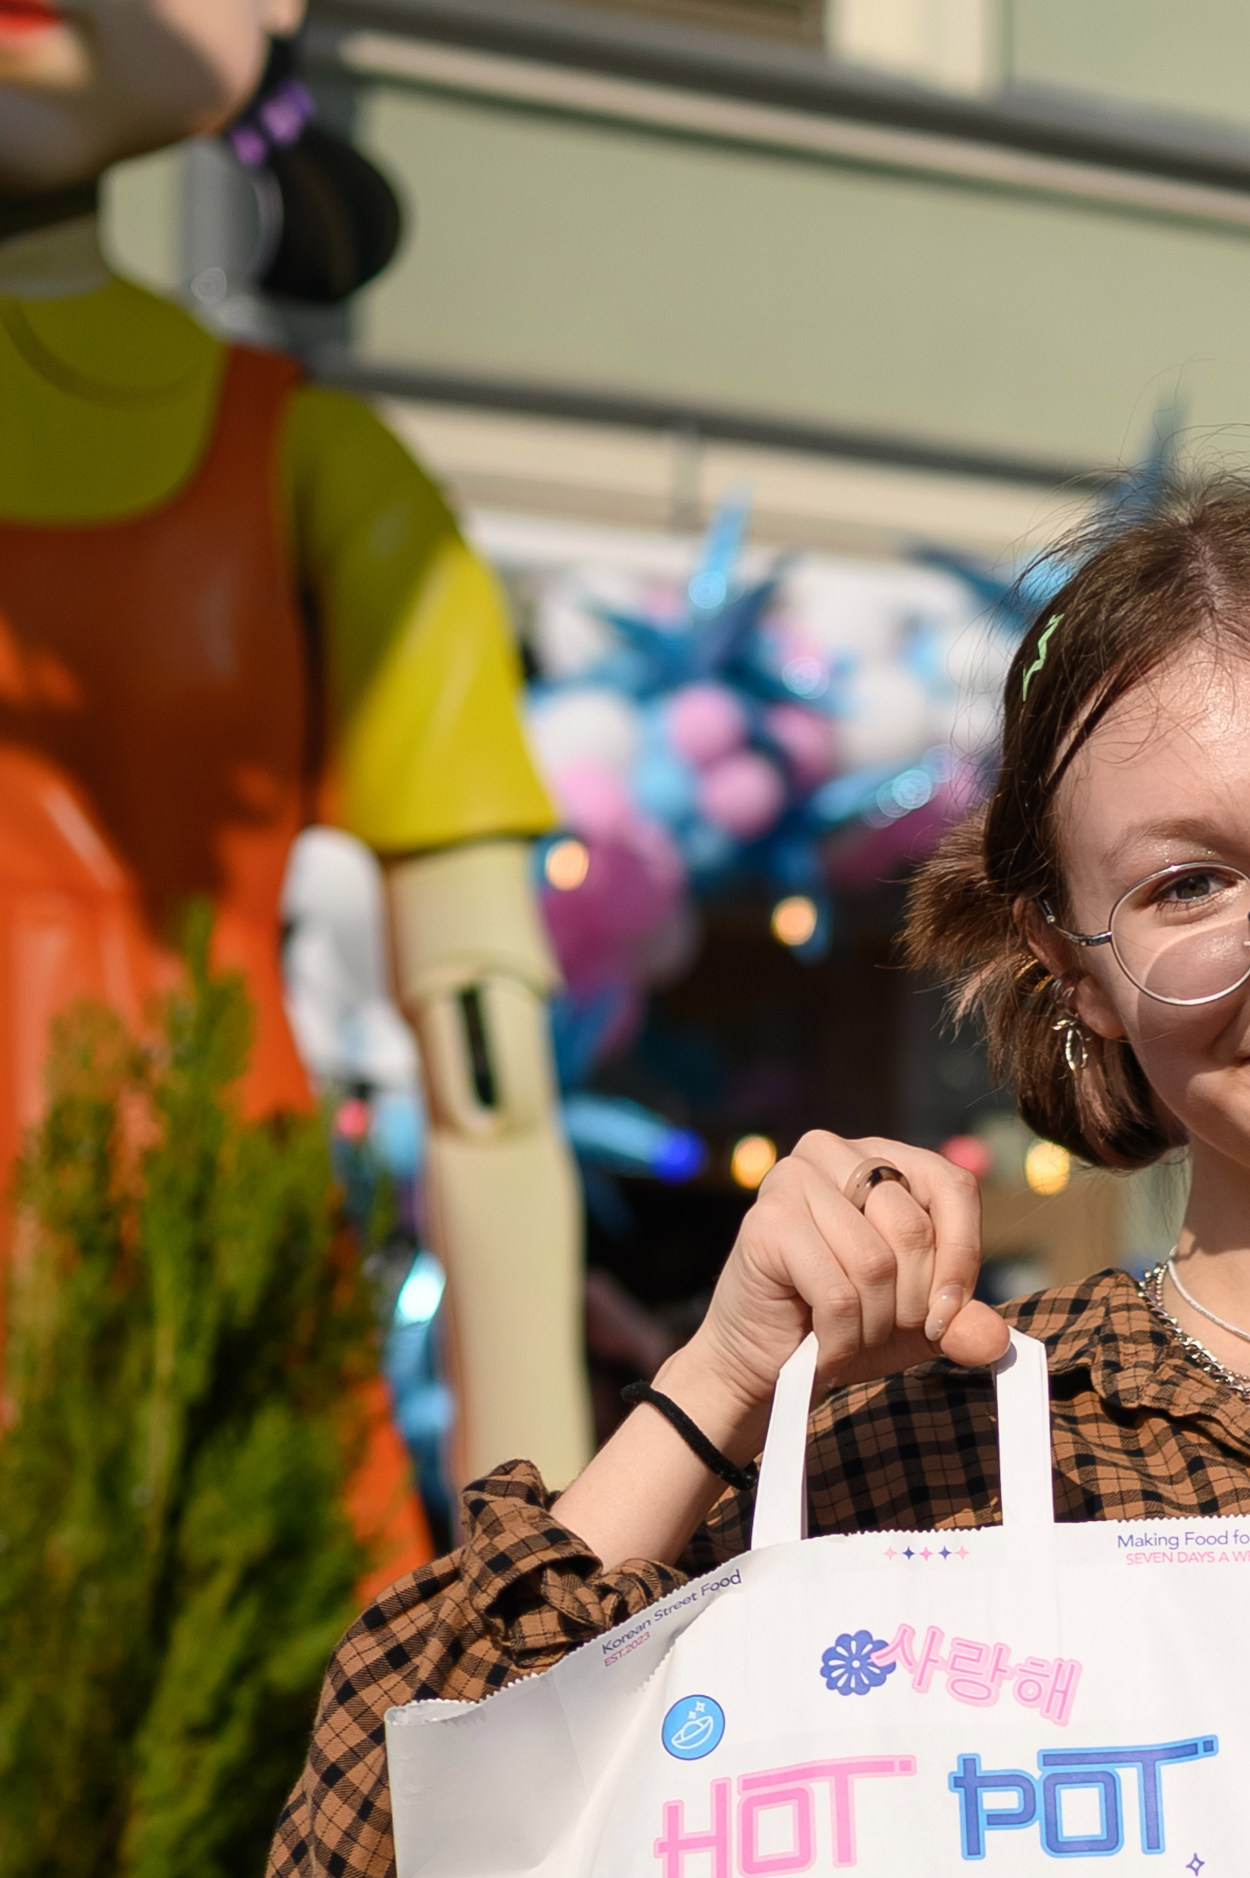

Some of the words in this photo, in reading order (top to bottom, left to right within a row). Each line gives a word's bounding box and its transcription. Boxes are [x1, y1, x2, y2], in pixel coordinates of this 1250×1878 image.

[1116, 1532, 1180, 1551] Making
[1184, 1530, 1229, 1547] Food
[1125, 1551, 1174, 1566] SEVEN
[1177, 1550, 1216, 1564] DAYS
[1218, 1550, 1230, 1563] A
[601, 1619, 651, 1655] Korean
[653, 1592, 698, 1622] Street
[700, 1568, 742, 1596] Food
[869, 1622, 1083, 1728] 사랑해
[948, 1734, 1219, 1861] POT
